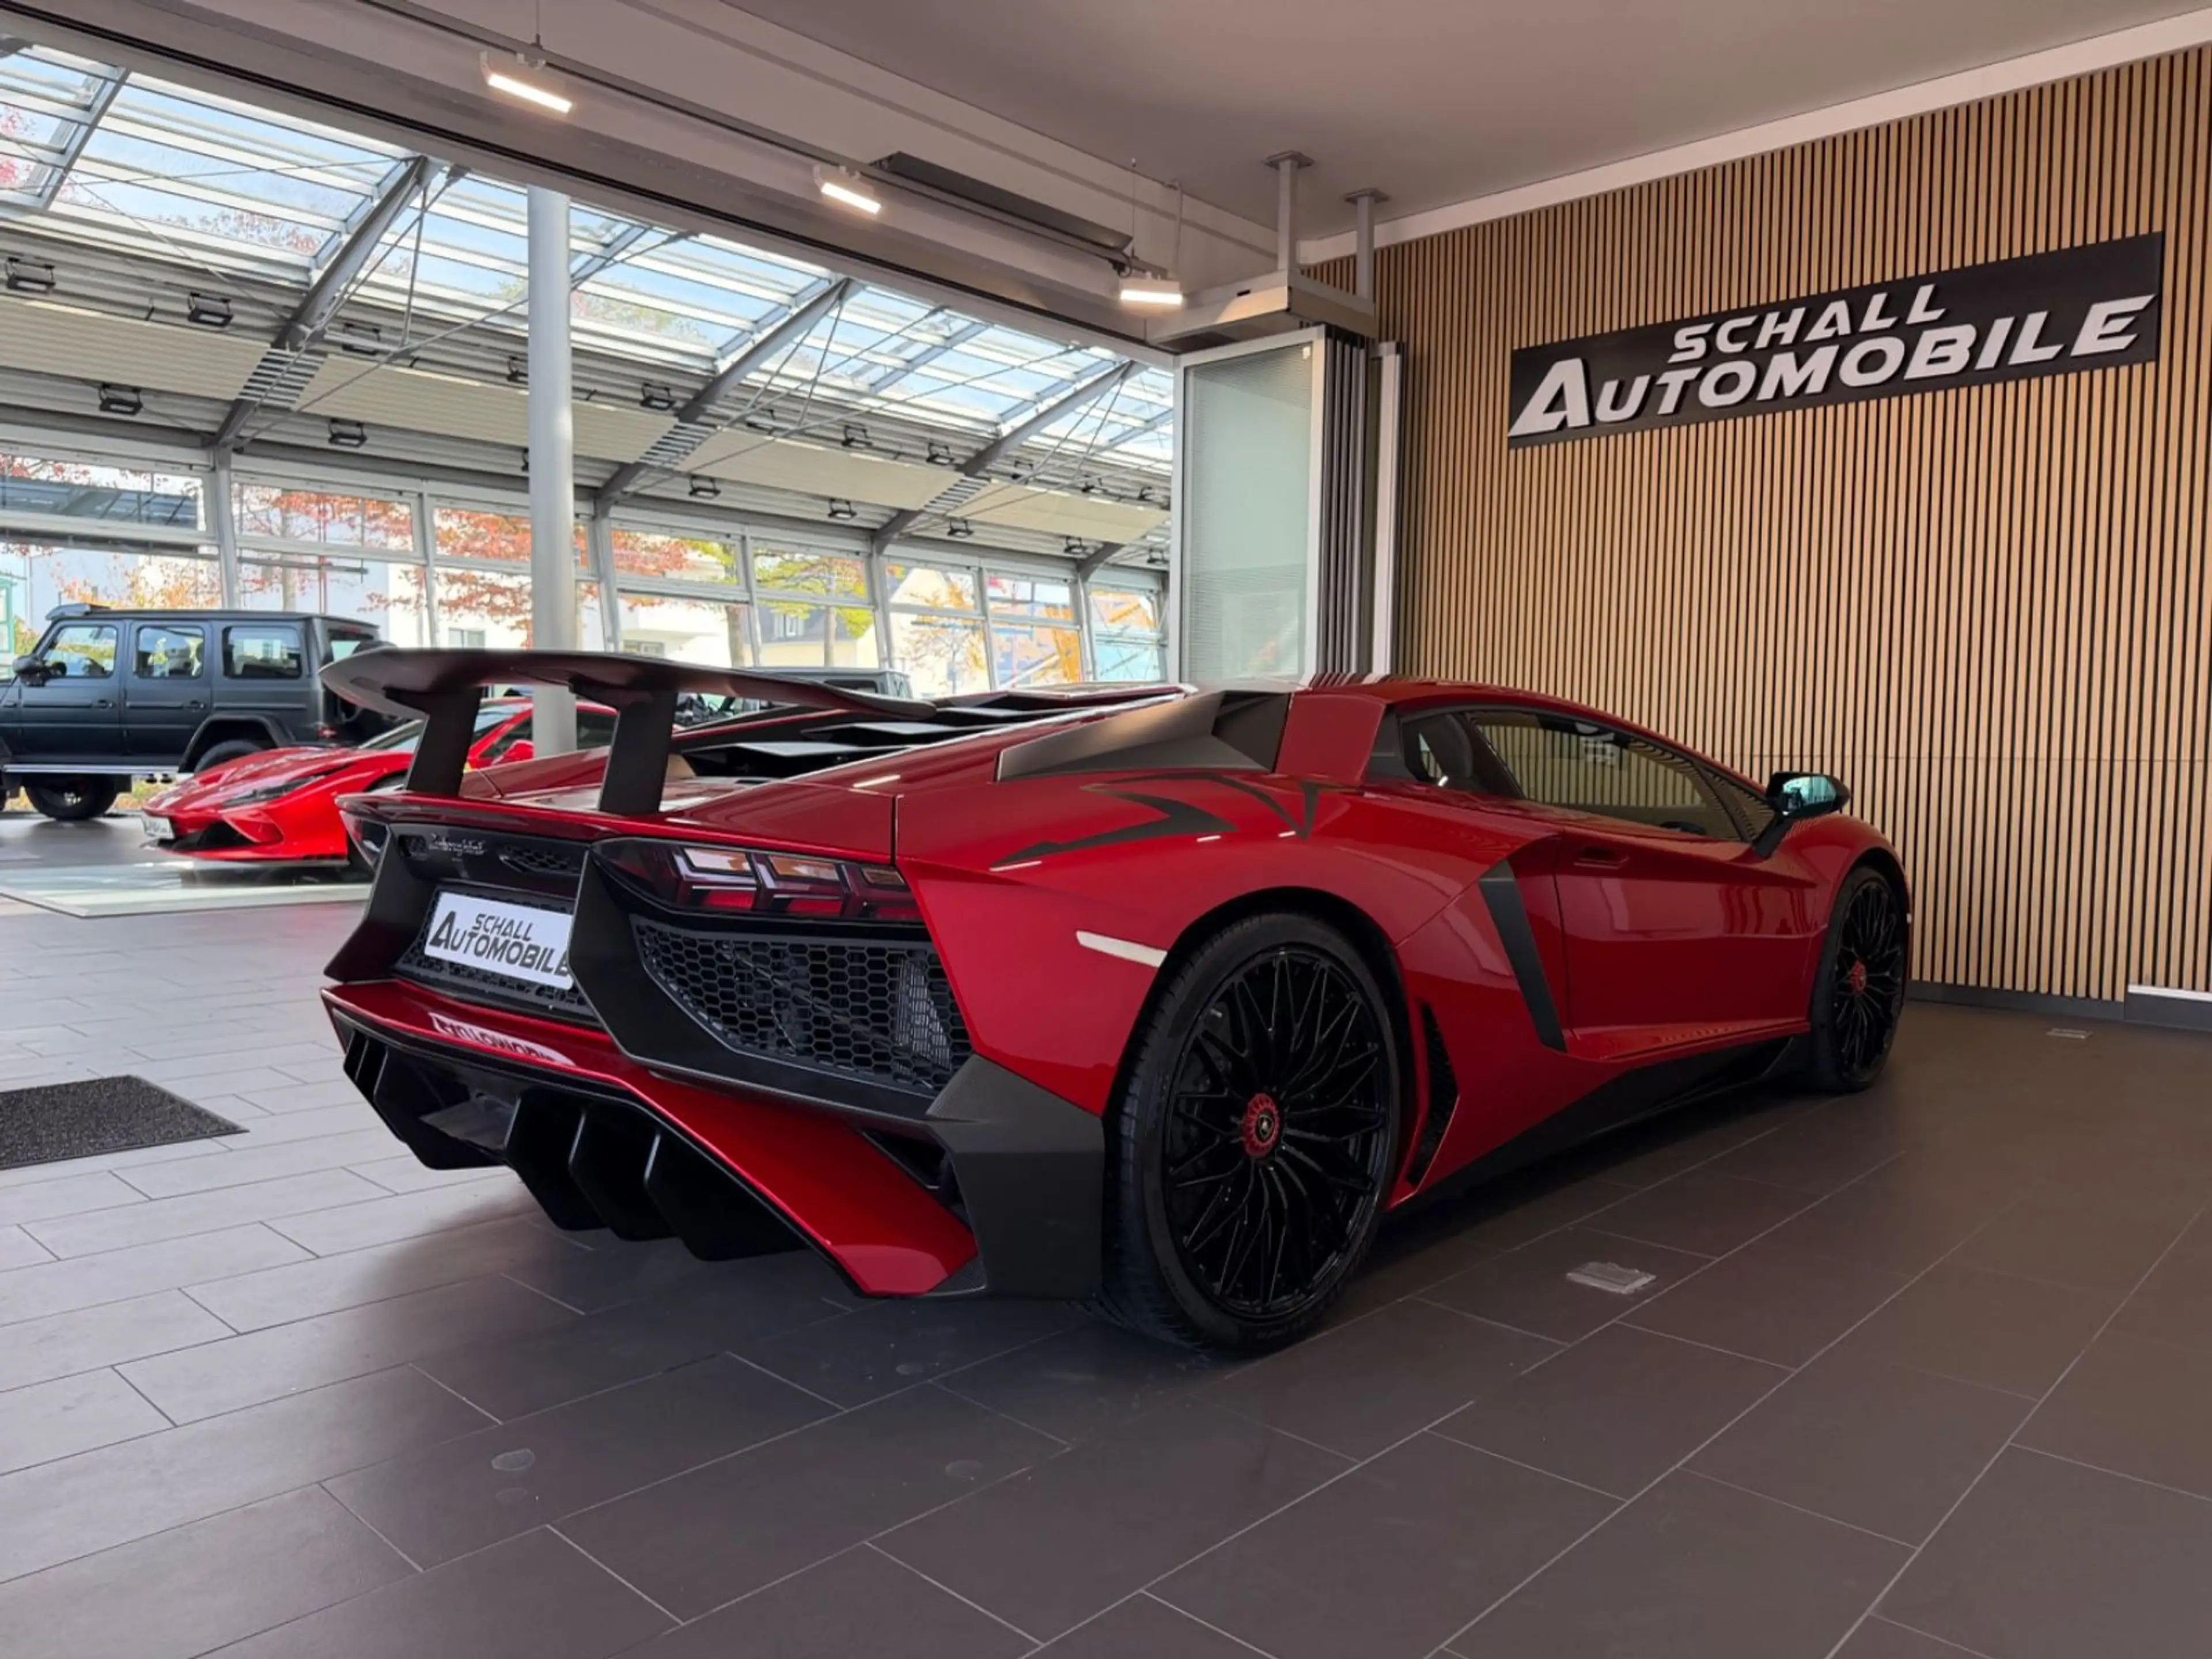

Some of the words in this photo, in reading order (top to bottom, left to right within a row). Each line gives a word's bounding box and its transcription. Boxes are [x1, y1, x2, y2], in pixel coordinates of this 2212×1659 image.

[1668, 284, 1946, 363] SCHALL
[1508, 294, 2155, 437] AUTOMOBILE
[472, 914, 533, 941] SCHALL
